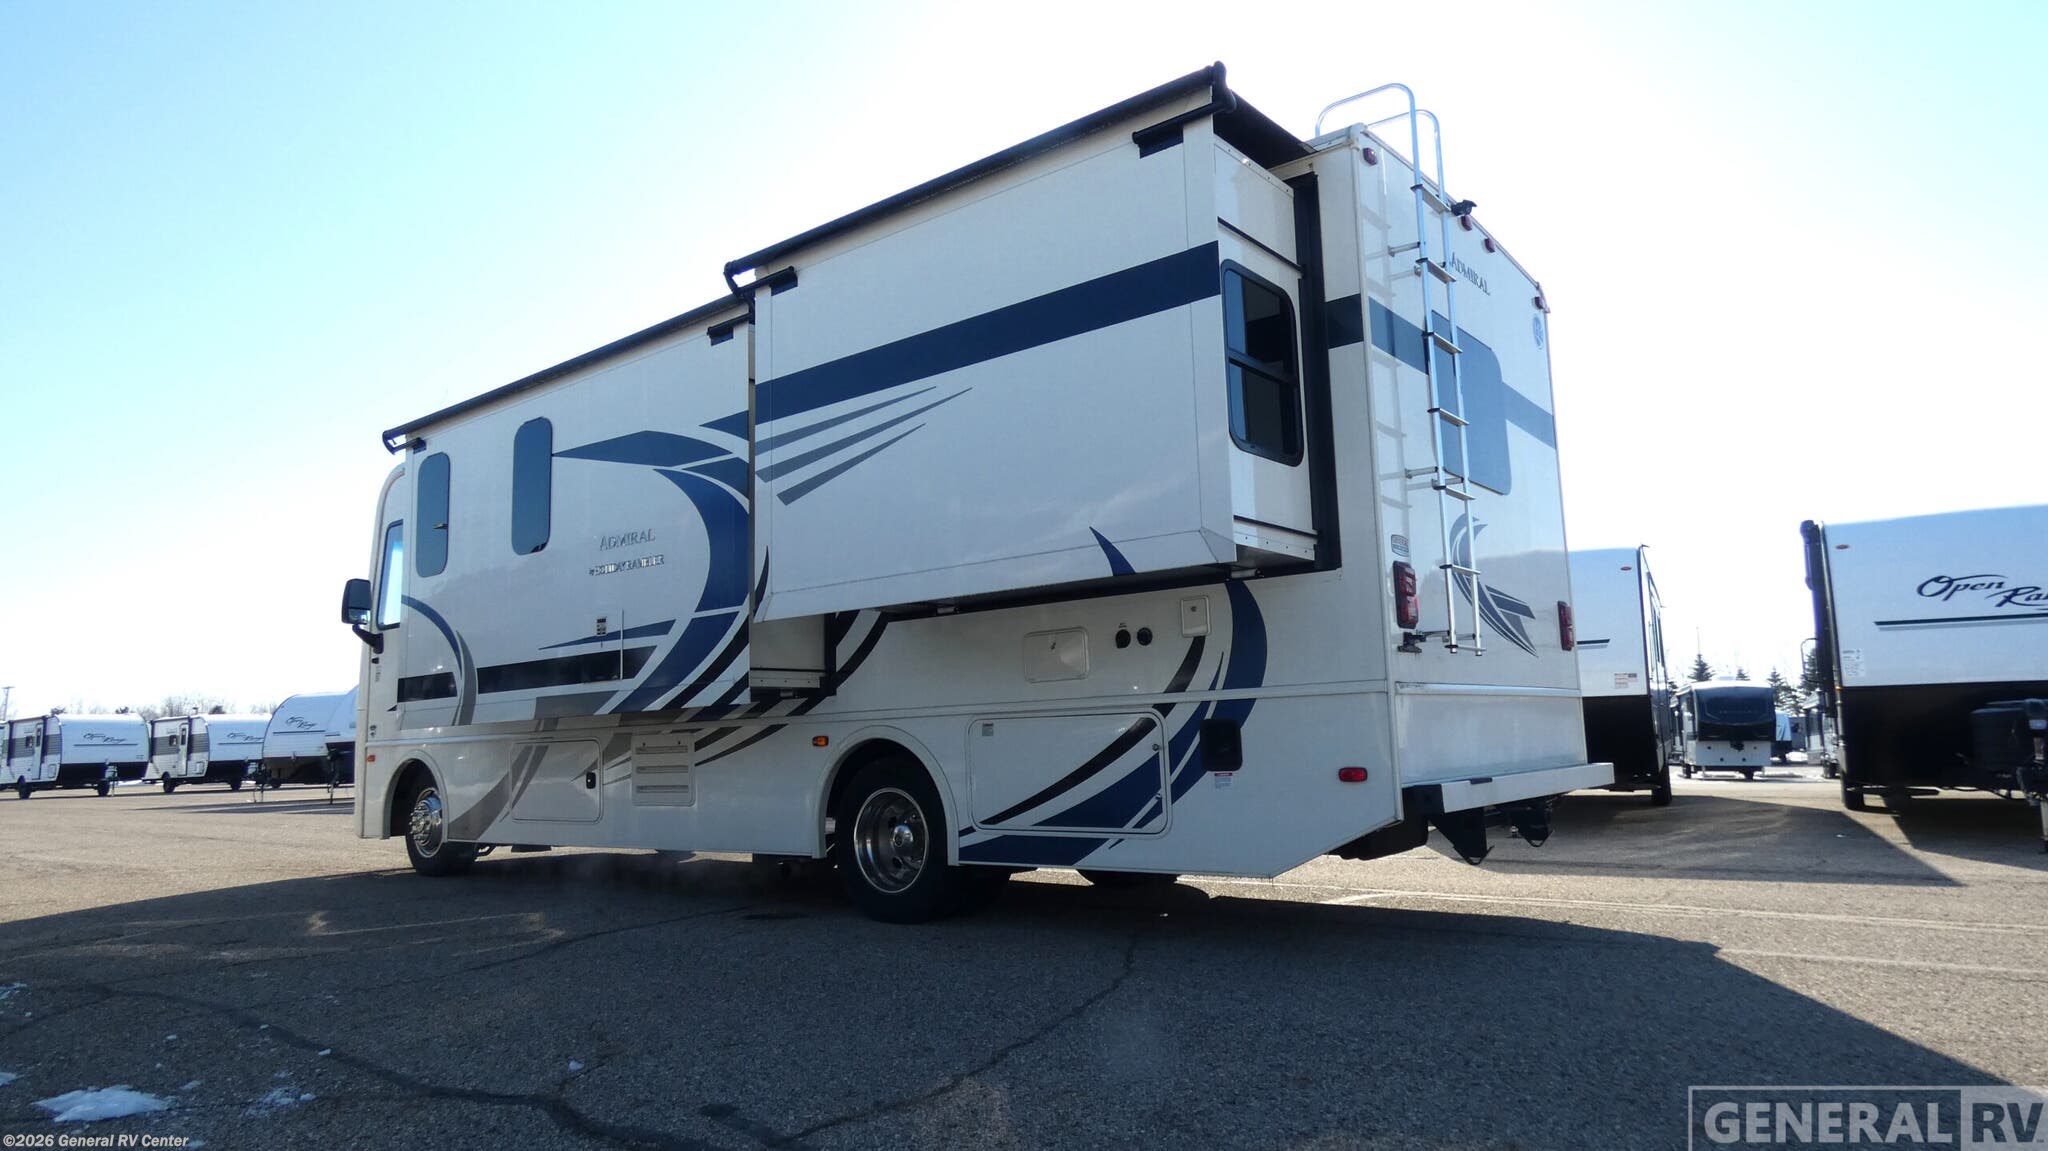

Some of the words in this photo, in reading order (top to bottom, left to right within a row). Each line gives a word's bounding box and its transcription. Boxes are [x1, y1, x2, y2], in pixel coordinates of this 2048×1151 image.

[1449, 251, 1491, 296] ADMIRAL
[600, 528, 656, 551] ADMIRAL
[1917, 574, 2008, 602] Open
